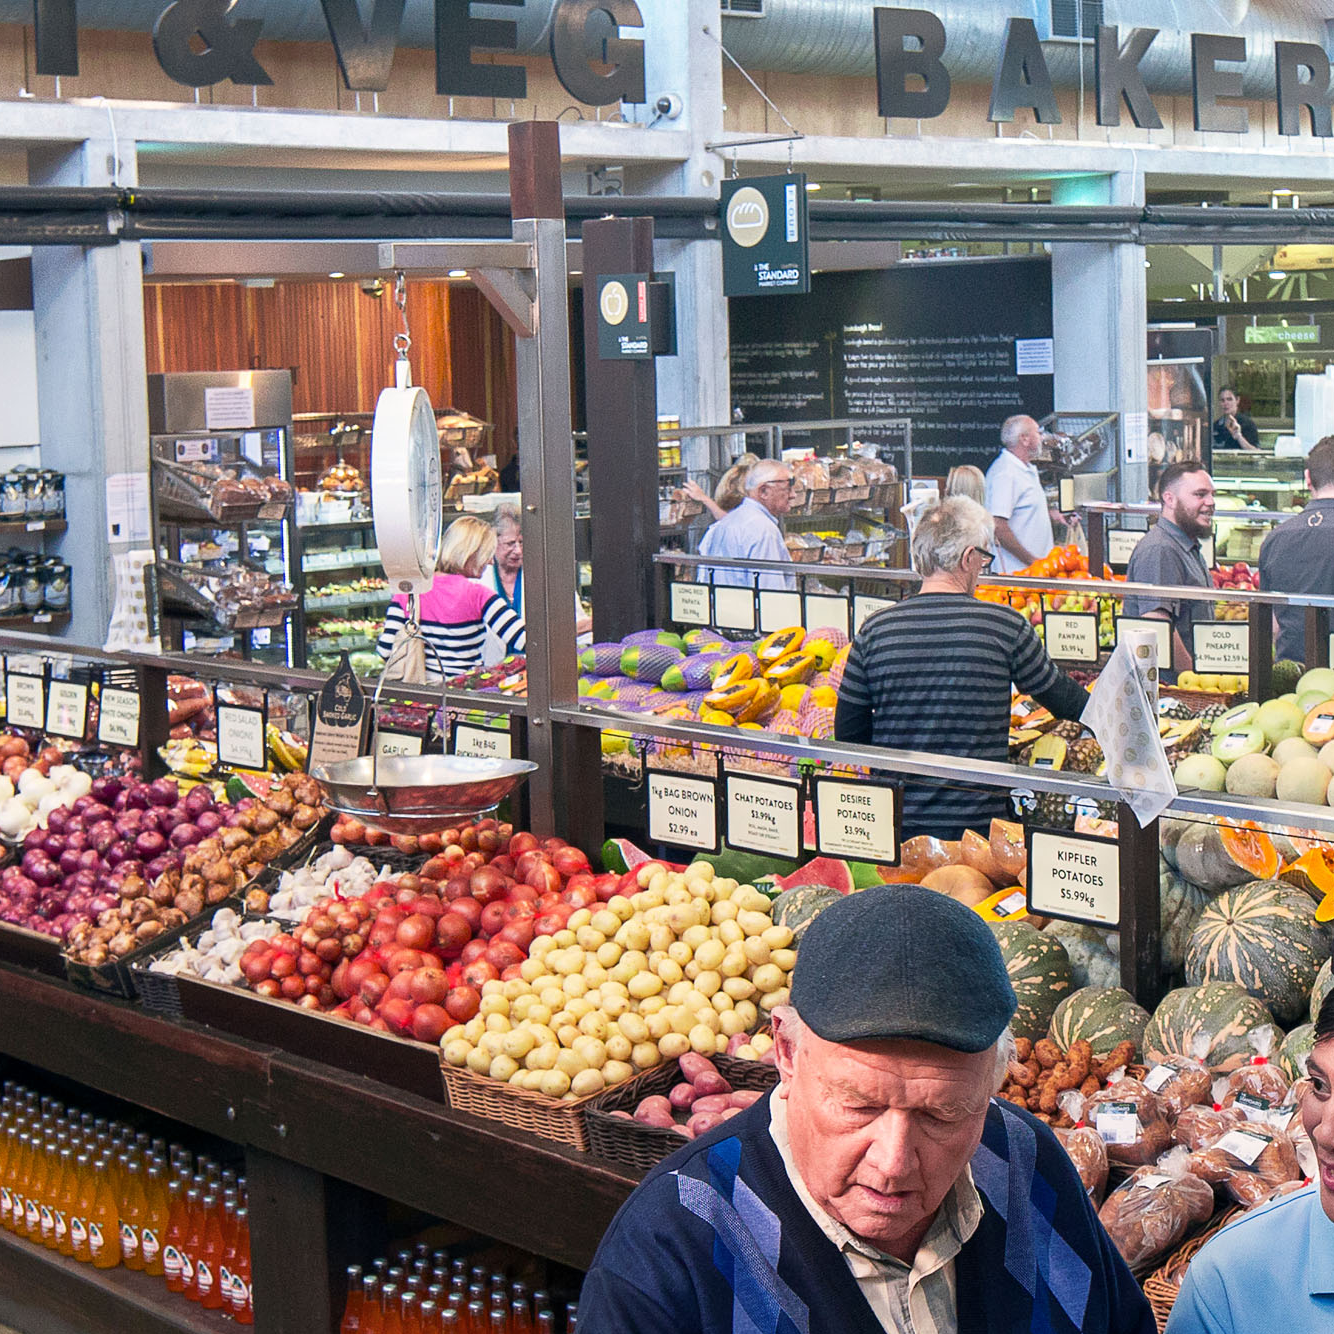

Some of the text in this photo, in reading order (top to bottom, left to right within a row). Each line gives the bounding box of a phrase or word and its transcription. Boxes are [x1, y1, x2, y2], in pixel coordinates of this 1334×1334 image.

[312, 0, 646, 106] VEG
[873, 8, 1334, 138] BAKER
[758, 271, 799, 280] STANDARD
[1278, 330, 1315, 340] cheese
[1212, 631, 1231, 639] GOLD
[482, 739, 496, 750] BAG
[652, 786, 714, 802] 1kg BAG BROWN
[734, 792, 793, 810] CHAT POTATOES
[840, 793, 871, 806] DESIREE
[668, 806, 697, 818] ONION
[751, 810, 776, 825] $3.99kg
[837, 809, 875, 822] POTATOES
[669, 823, 689, 835] $2.99
[844, 825, 870, 840] $3.99kg
[1057, 851, 1097, 866] KIPFLER
[1052, 868, 1103, 886] POTATOES
[1060, 888, 1094, 908] $5.99kg
